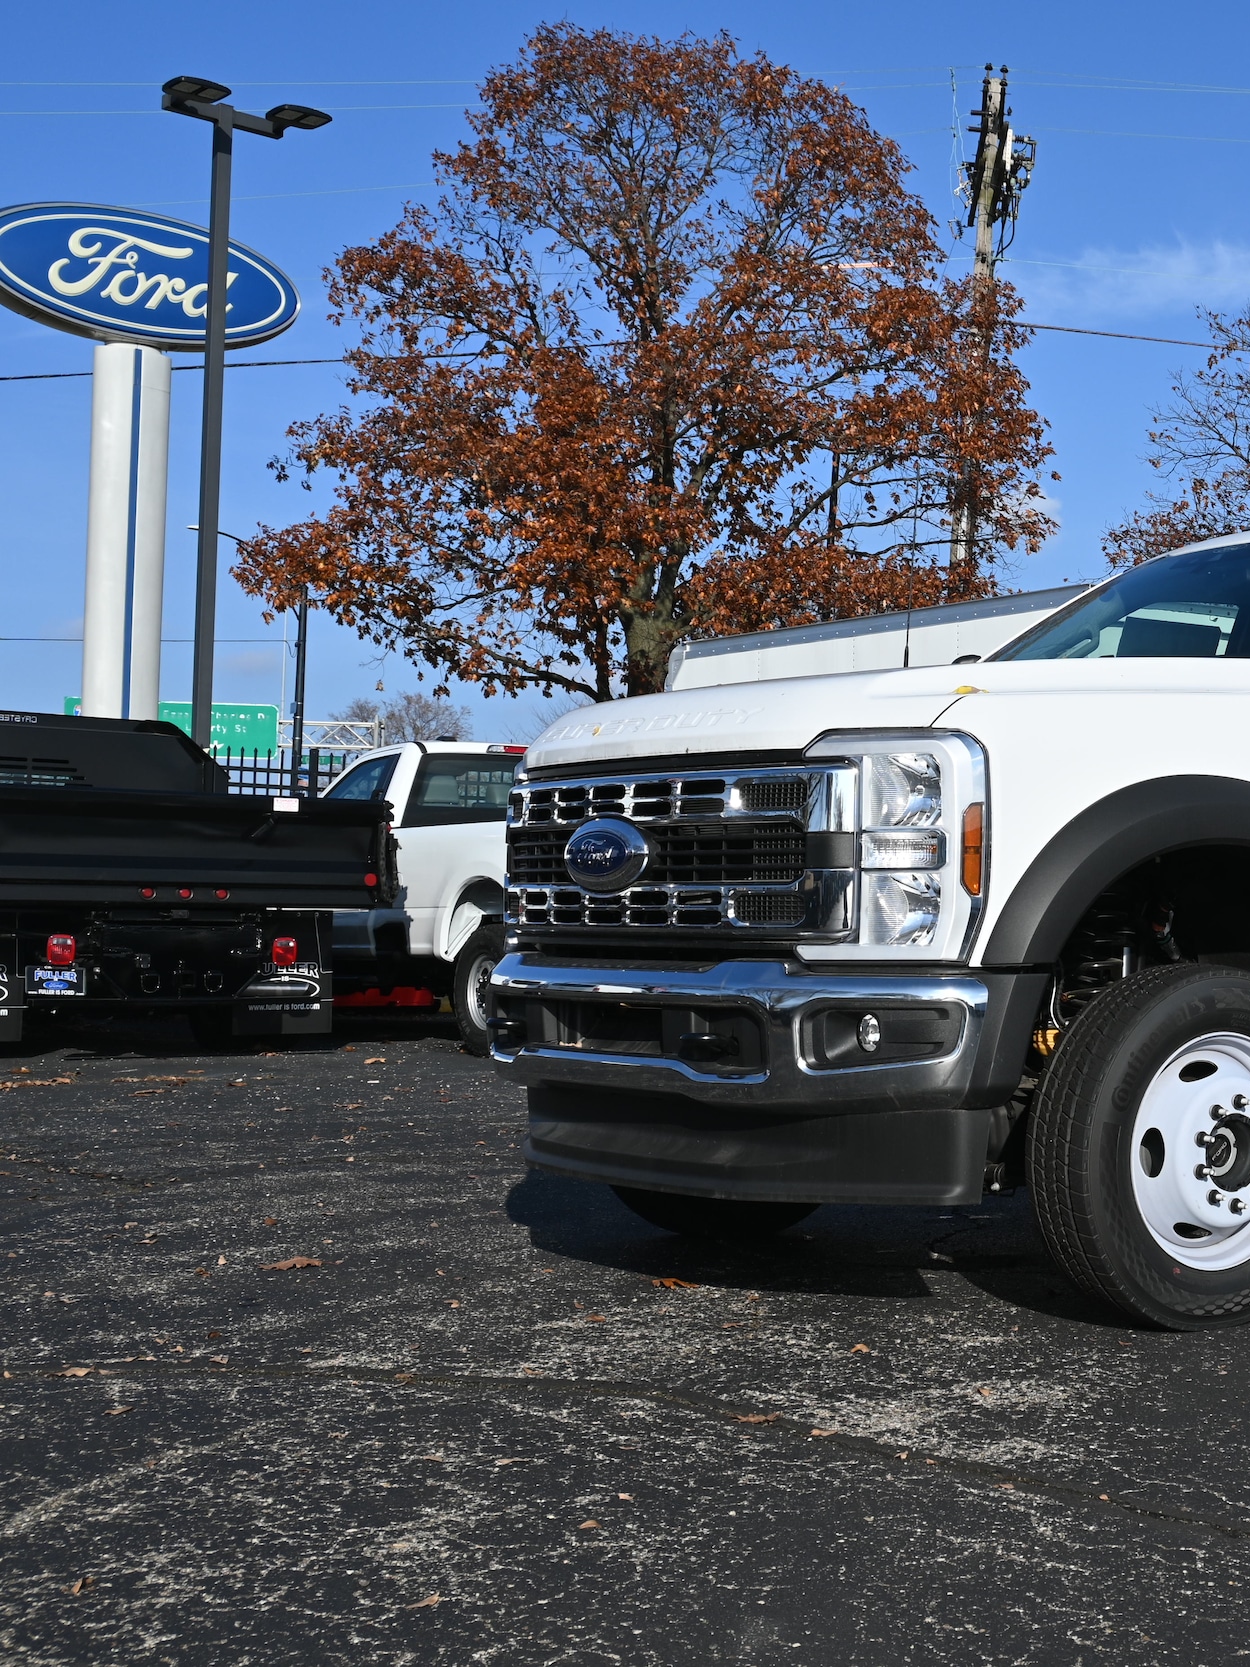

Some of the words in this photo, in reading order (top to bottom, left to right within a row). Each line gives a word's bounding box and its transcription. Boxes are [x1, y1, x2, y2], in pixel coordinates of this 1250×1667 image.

[48, 227, 239, 319] Ford
[211, 711, 251, 719] harles
[573, 836, 618, 869] Ford
[34, 969, 78, 983] FULLER
[261, 962, 320, 979] ULLER
